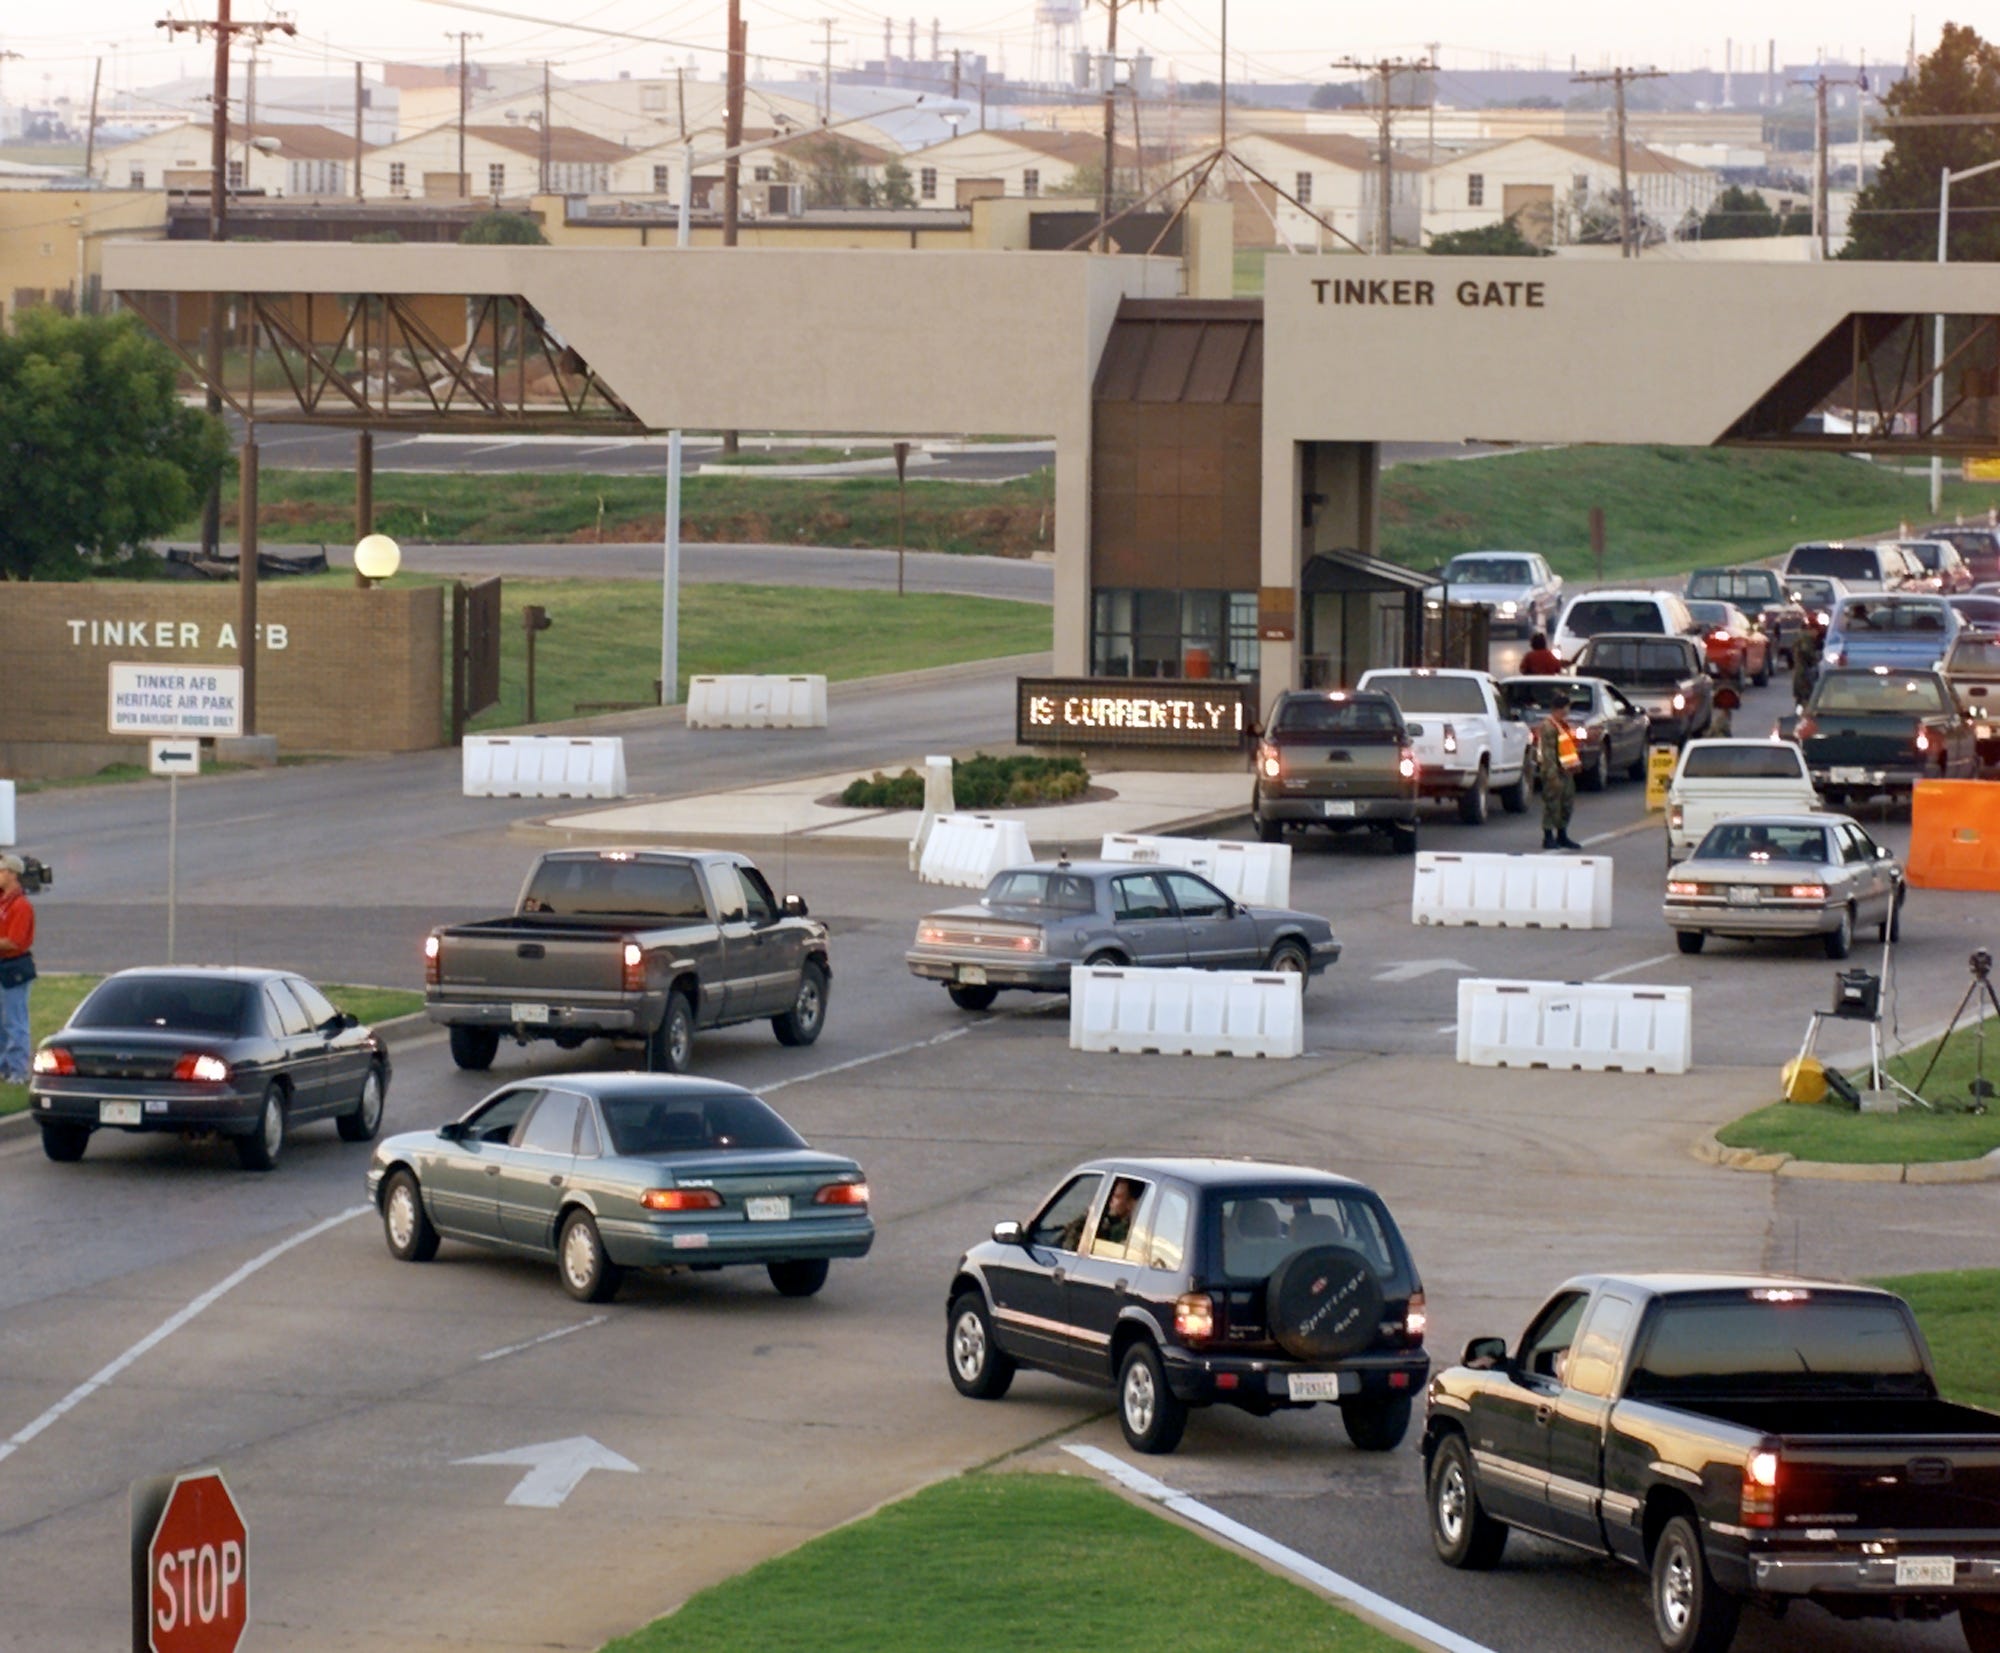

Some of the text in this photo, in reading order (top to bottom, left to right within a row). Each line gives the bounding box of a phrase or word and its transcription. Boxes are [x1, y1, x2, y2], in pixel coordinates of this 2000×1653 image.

[1312, 279, 1545, 308] TINKER GATE
[67, 619, 289, 651] TINKER AB
[135, 674, 217, 691] TINKER AFB
[116, 693, 234, 710] HERITAGE AIR PARK
[1030, 696, 1055, 726] IS
[1063, 697, 1226, 730] CURRENTLY
[116, 712, 138, 725] OPEN
[140, 712, 178, 726] DAYLIGHT
[213, 714, 233, 727] ONLY
[157, 1539, 242, 1633] STOP
